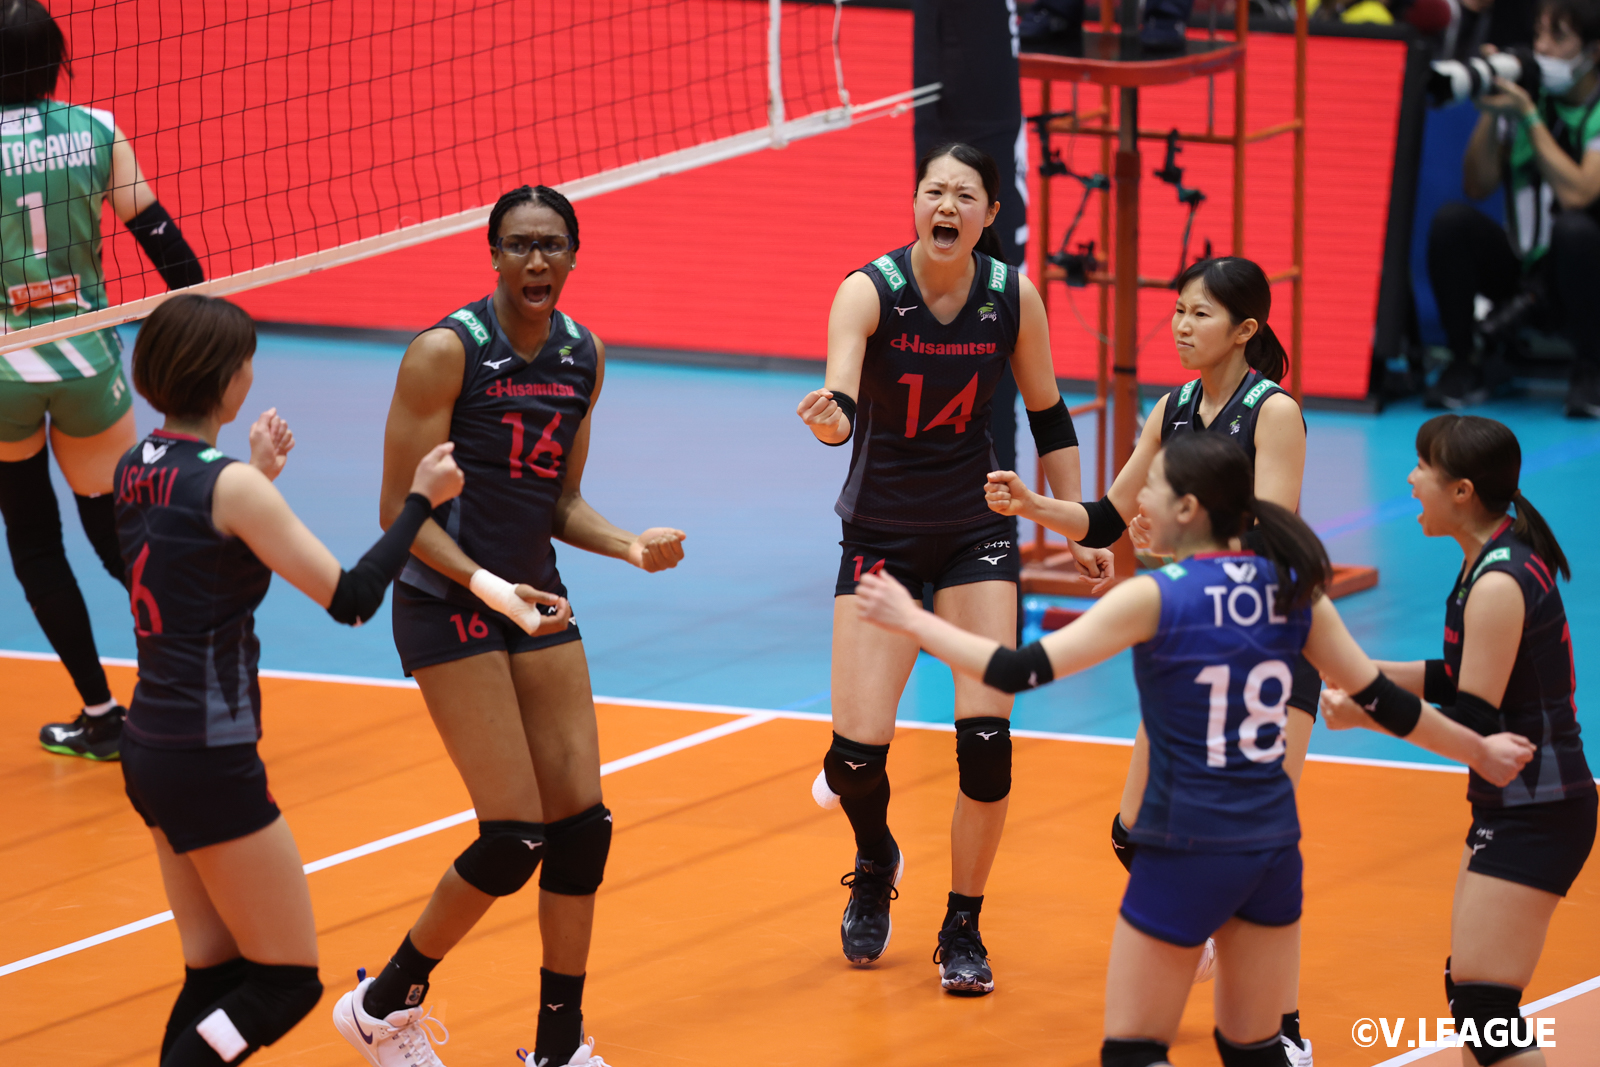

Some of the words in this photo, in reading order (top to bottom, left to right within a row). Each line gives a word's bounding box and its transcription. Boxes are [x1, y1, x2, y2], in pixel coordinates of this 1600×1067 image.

[16, 191, 48, 260] 1
[890, 333, 997, 355] Hisamitsu
[486, 377, 576, 398] Hisamitsu
[897, 371, 979, 439] 14
[501, 411, 563, 479] 16
[130, 541, 164, 638] 6
[450, 611, 489, 643] 16
[1194, 660, 1293, 768] 18
